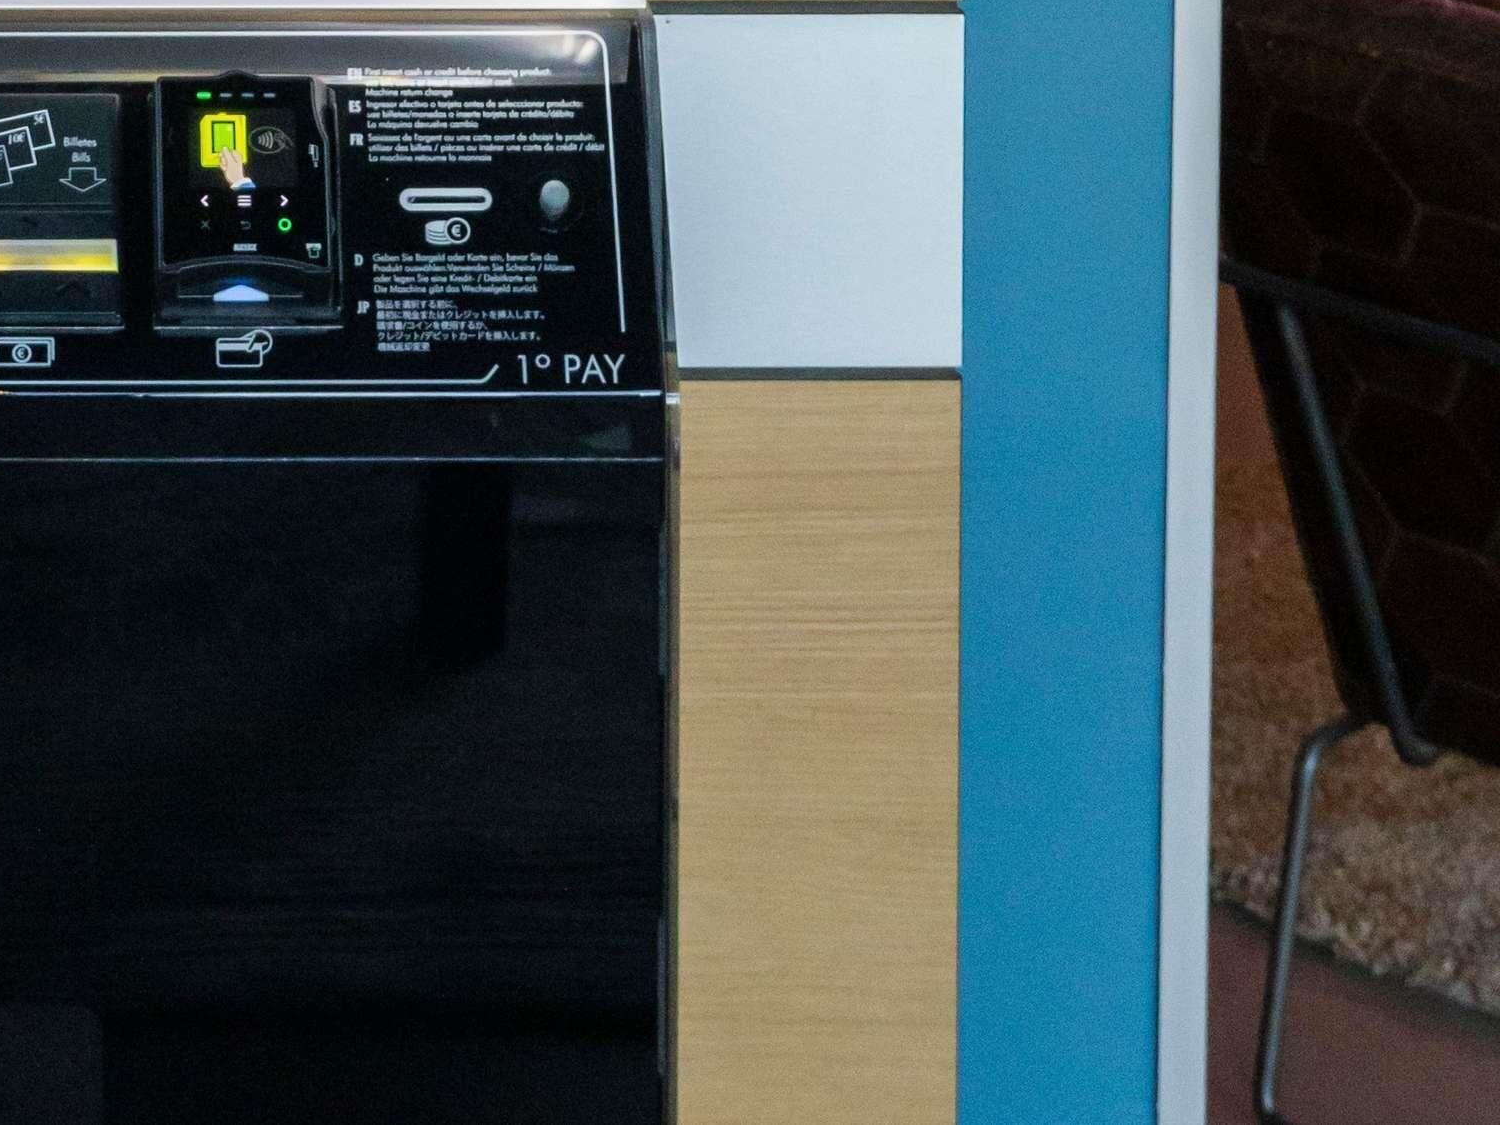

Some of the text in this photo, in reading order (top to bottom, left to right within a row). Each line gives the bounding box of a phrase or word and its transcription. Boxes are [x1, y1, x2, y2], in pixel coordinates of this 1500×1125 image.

[348, 99, 362, 113] ES
[63, 137, 97, 148] Billetes
[350, 133, 363, 146] FR
[72, 152, 91, 163] Bills
[354, 254, 364, 266] D
[357, 300, 370, 314] JP
[564, 353, 625, 384] PAY
